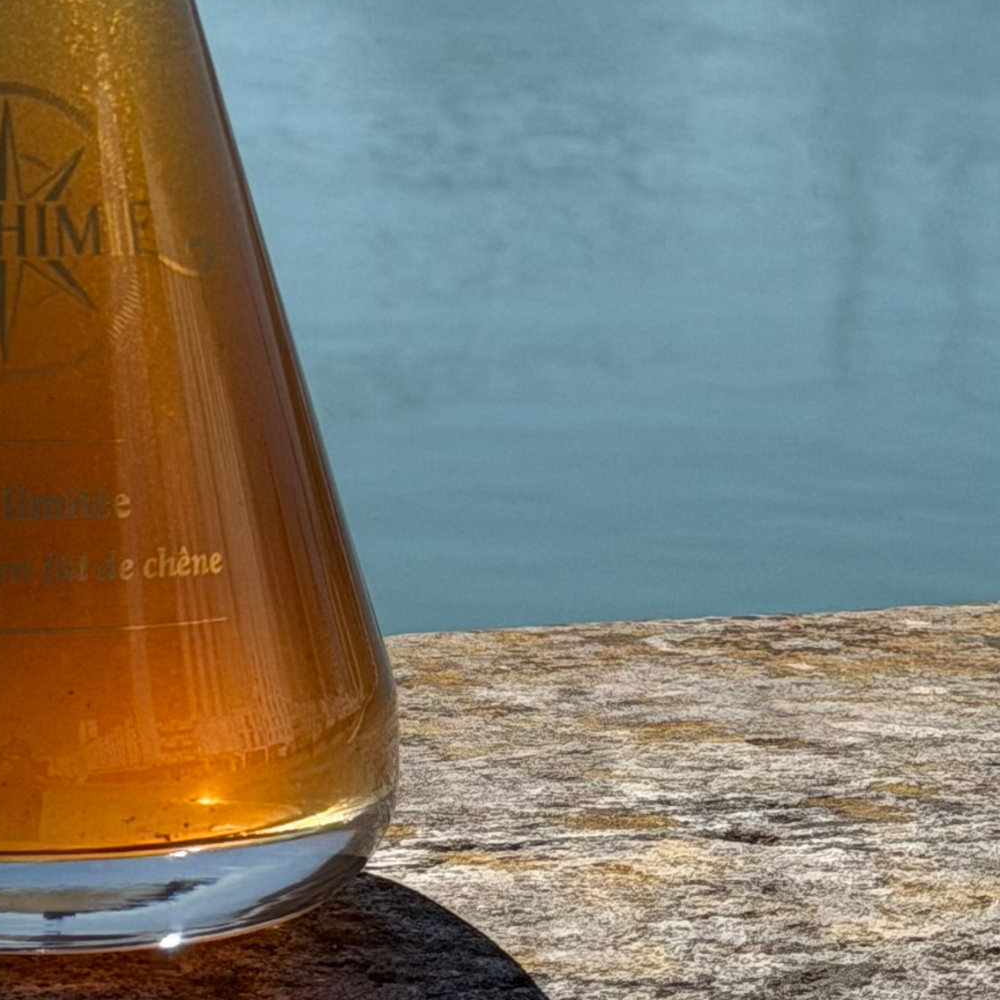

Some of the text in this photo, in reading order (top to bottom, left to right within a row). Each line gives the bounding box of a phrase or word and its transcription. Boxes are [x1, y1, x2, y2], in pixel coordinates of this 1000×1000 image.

[2, 480, 132, 520] limitée
[96, 548, 135, 582] de
[142, 545, 225, 580] chêne
